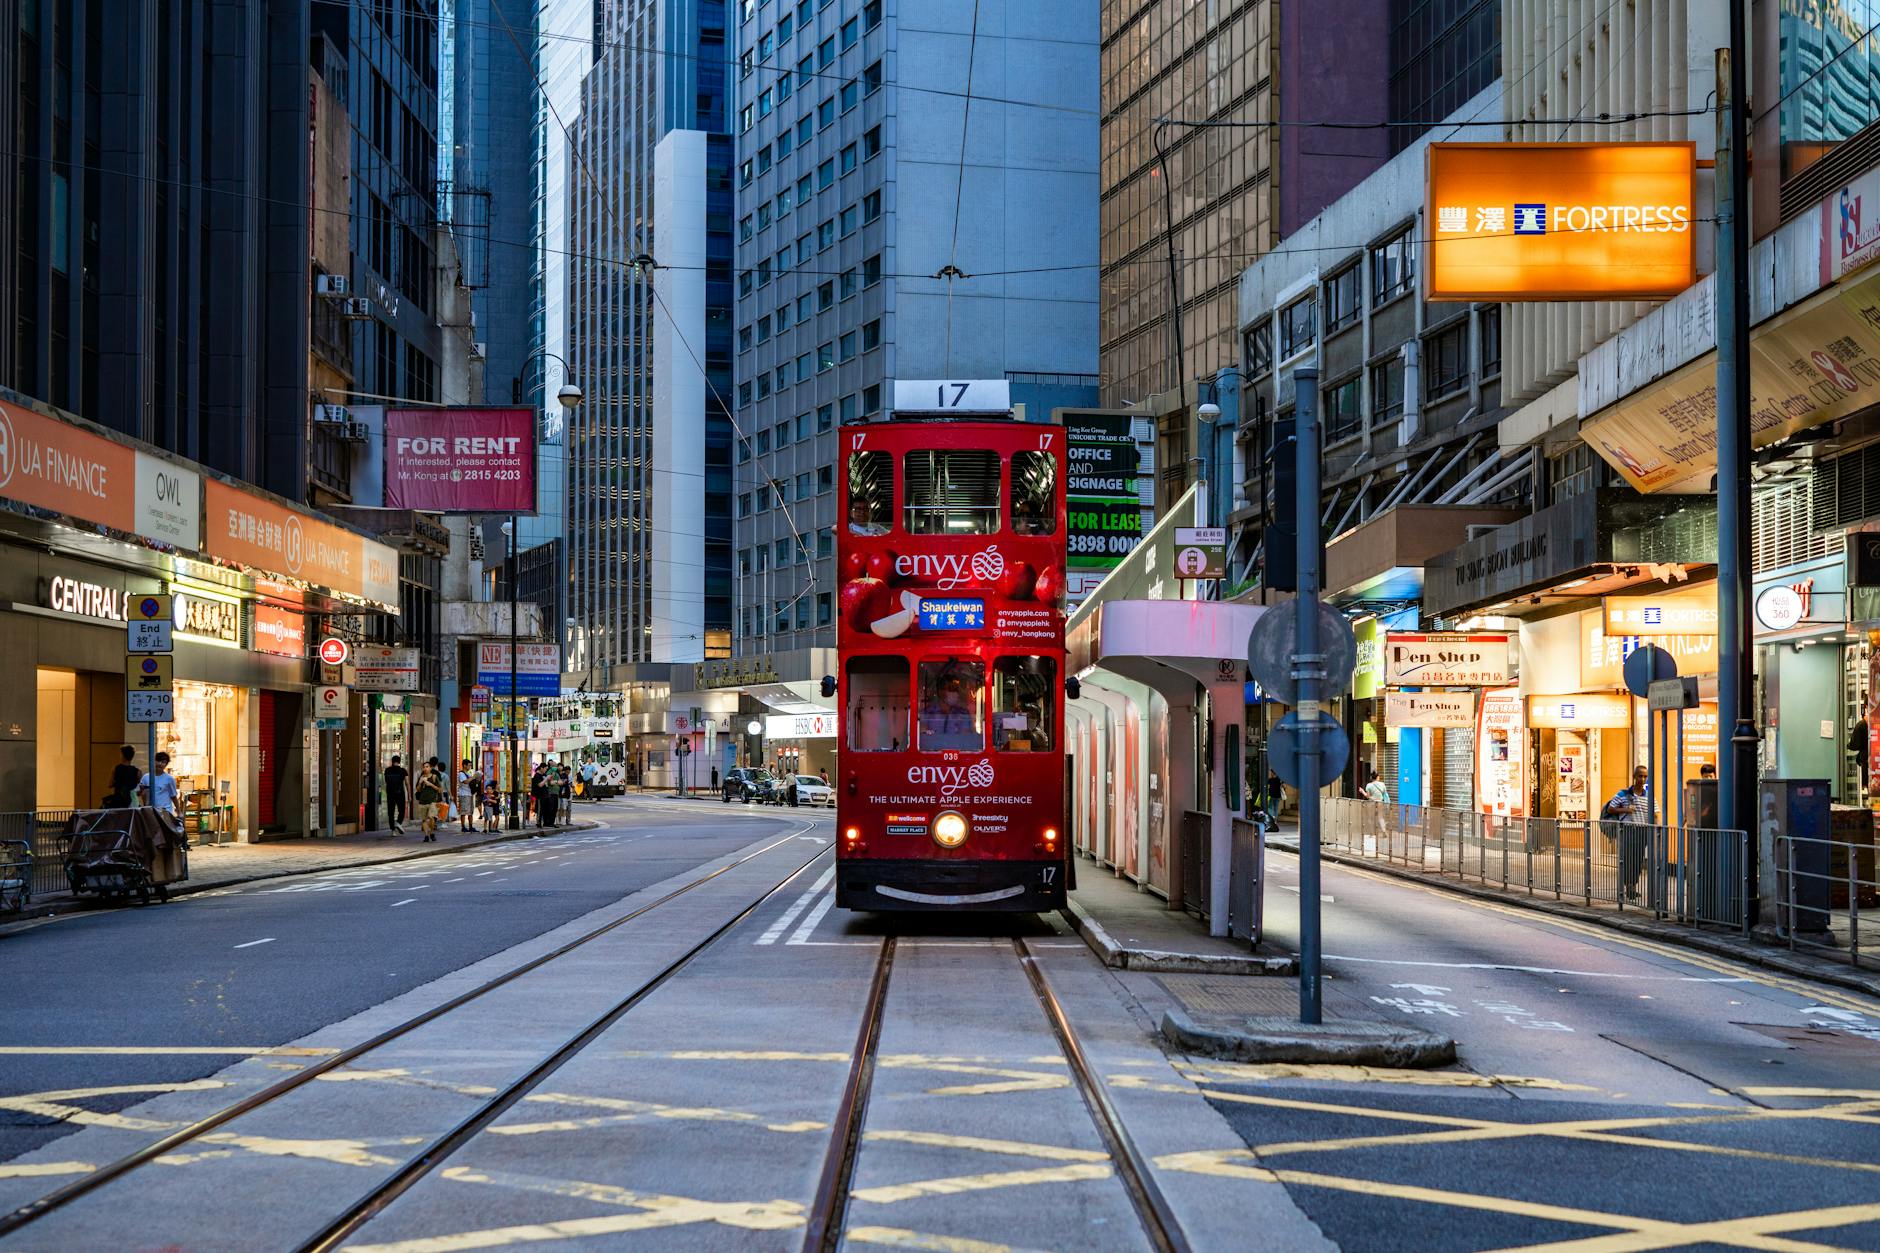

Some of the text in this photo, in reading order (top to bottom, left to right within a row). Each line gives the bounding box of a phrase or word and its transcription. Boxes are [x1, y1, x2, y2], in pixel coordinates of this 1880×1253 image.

[1438, 206, 1505, 232] 豐澤
[1553, 206, 1689, 233] FORTRESS
[938, 383, 970, 407] 17
[397, 437, 521, 455] FOR RENT
[852, 433, 866, 450] 17
[1039, 434, 1053, 449] 17
[398, 457, 521, 468] If interested, please contact
[1068, 448, 1112, 460] OFFICE
[19, 437, 43, 478] UA
[46, 447, 107, 498] FINANCE
[398, 470, 521, 481] Mr. Kong at 2815 4203
[1068, 462, 1093, 474] AND
[156, 471, 181, 506] OWL
[1068, 477, 1123, 490] SIGNAGE
[1069, 511, 1141, 531] FOR LEASE
[1068, 534, 1106, 553] 3898
[1511, 533, 1547, 567] BUILDING
[305, 538, 349, 575] UA FINANCE
[895, 554, 972, 591] envy
[52, 575, 121, 621] CENTRAL
[922, 602, 983, 613] Shaukeiwan
[998, 610, 1050, 619] envyapple.com
[1773, 610, 1789, 619] 360
[140, 624, 160, 633] End
[1007, 620, 1050, 628] envyapplehk
[136, 635, 164, 648] 終止
[1002, 630, 1056, 639] envy_hongkong
[1394, 646, 1480, 663] Pen Shop
[146, 695, 170, 704] 7-10
[145, 708, 164, 717] 4-7
[795, 718, 813, 735] HSBC
[908, 766, 969, 796] envy
[869, 796, 1033, 804] THE ULTIMATE APPLE EXPERIENCE
[1043, 866, 1056, 883] 17
